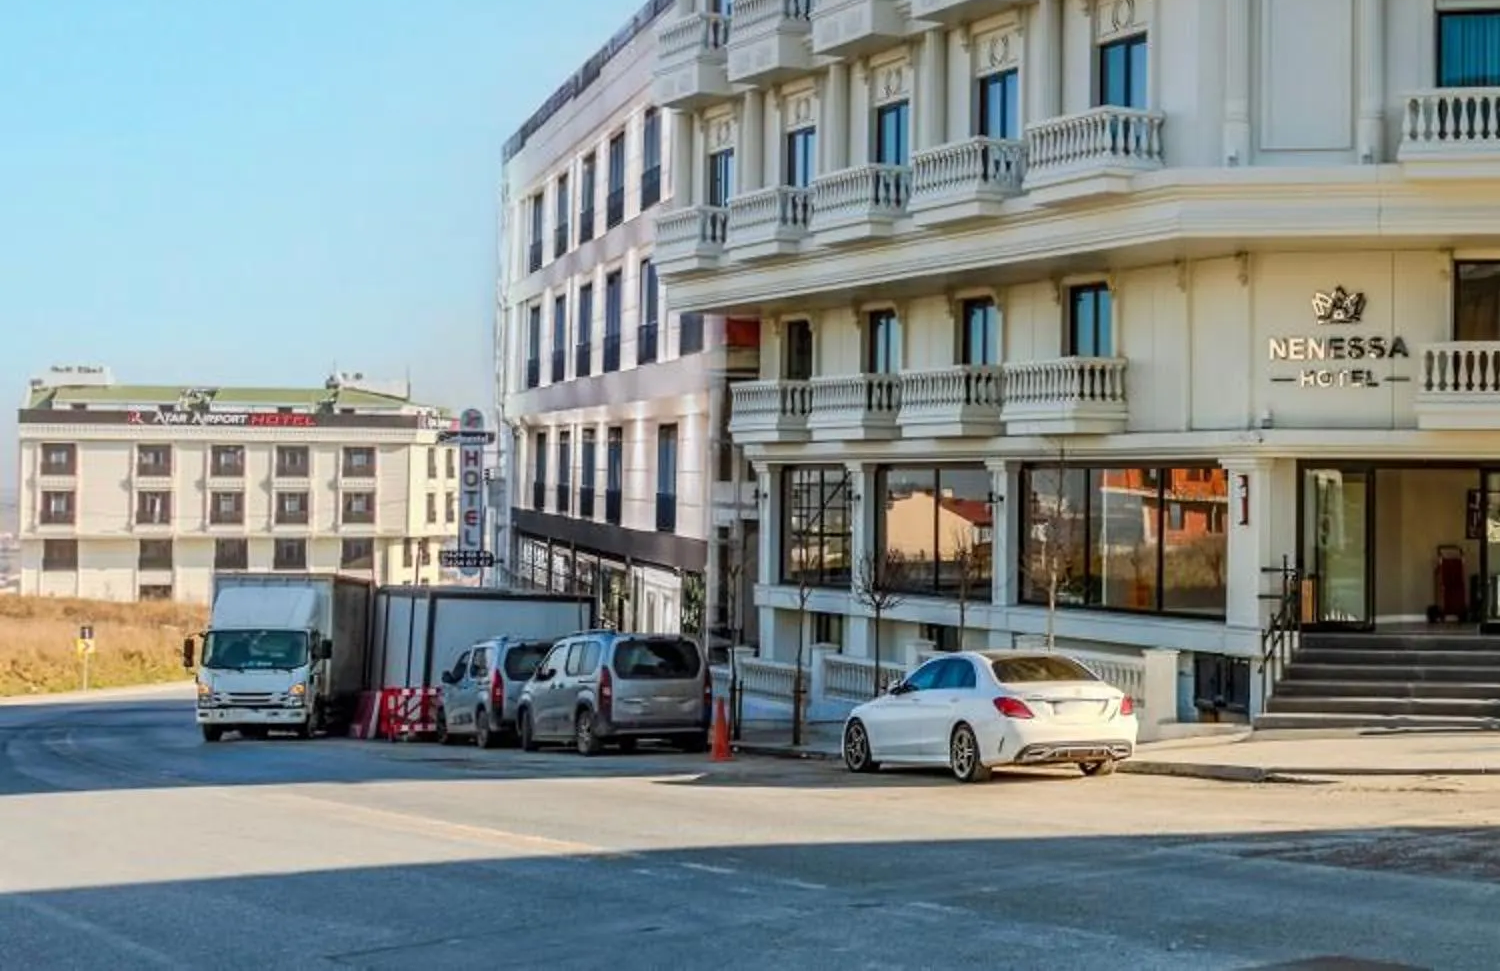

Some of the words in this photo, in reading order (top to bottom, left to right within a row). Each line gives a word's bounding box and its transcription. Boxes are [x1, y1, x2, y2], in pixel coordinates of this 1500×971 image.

[1269, 335, 1409, 359] NENESSA
[1300, 369, 1379, 387] HOTEL
[251, 414, 317, 426] HOTEL
[463, 450, 479, 547] HOTEL
